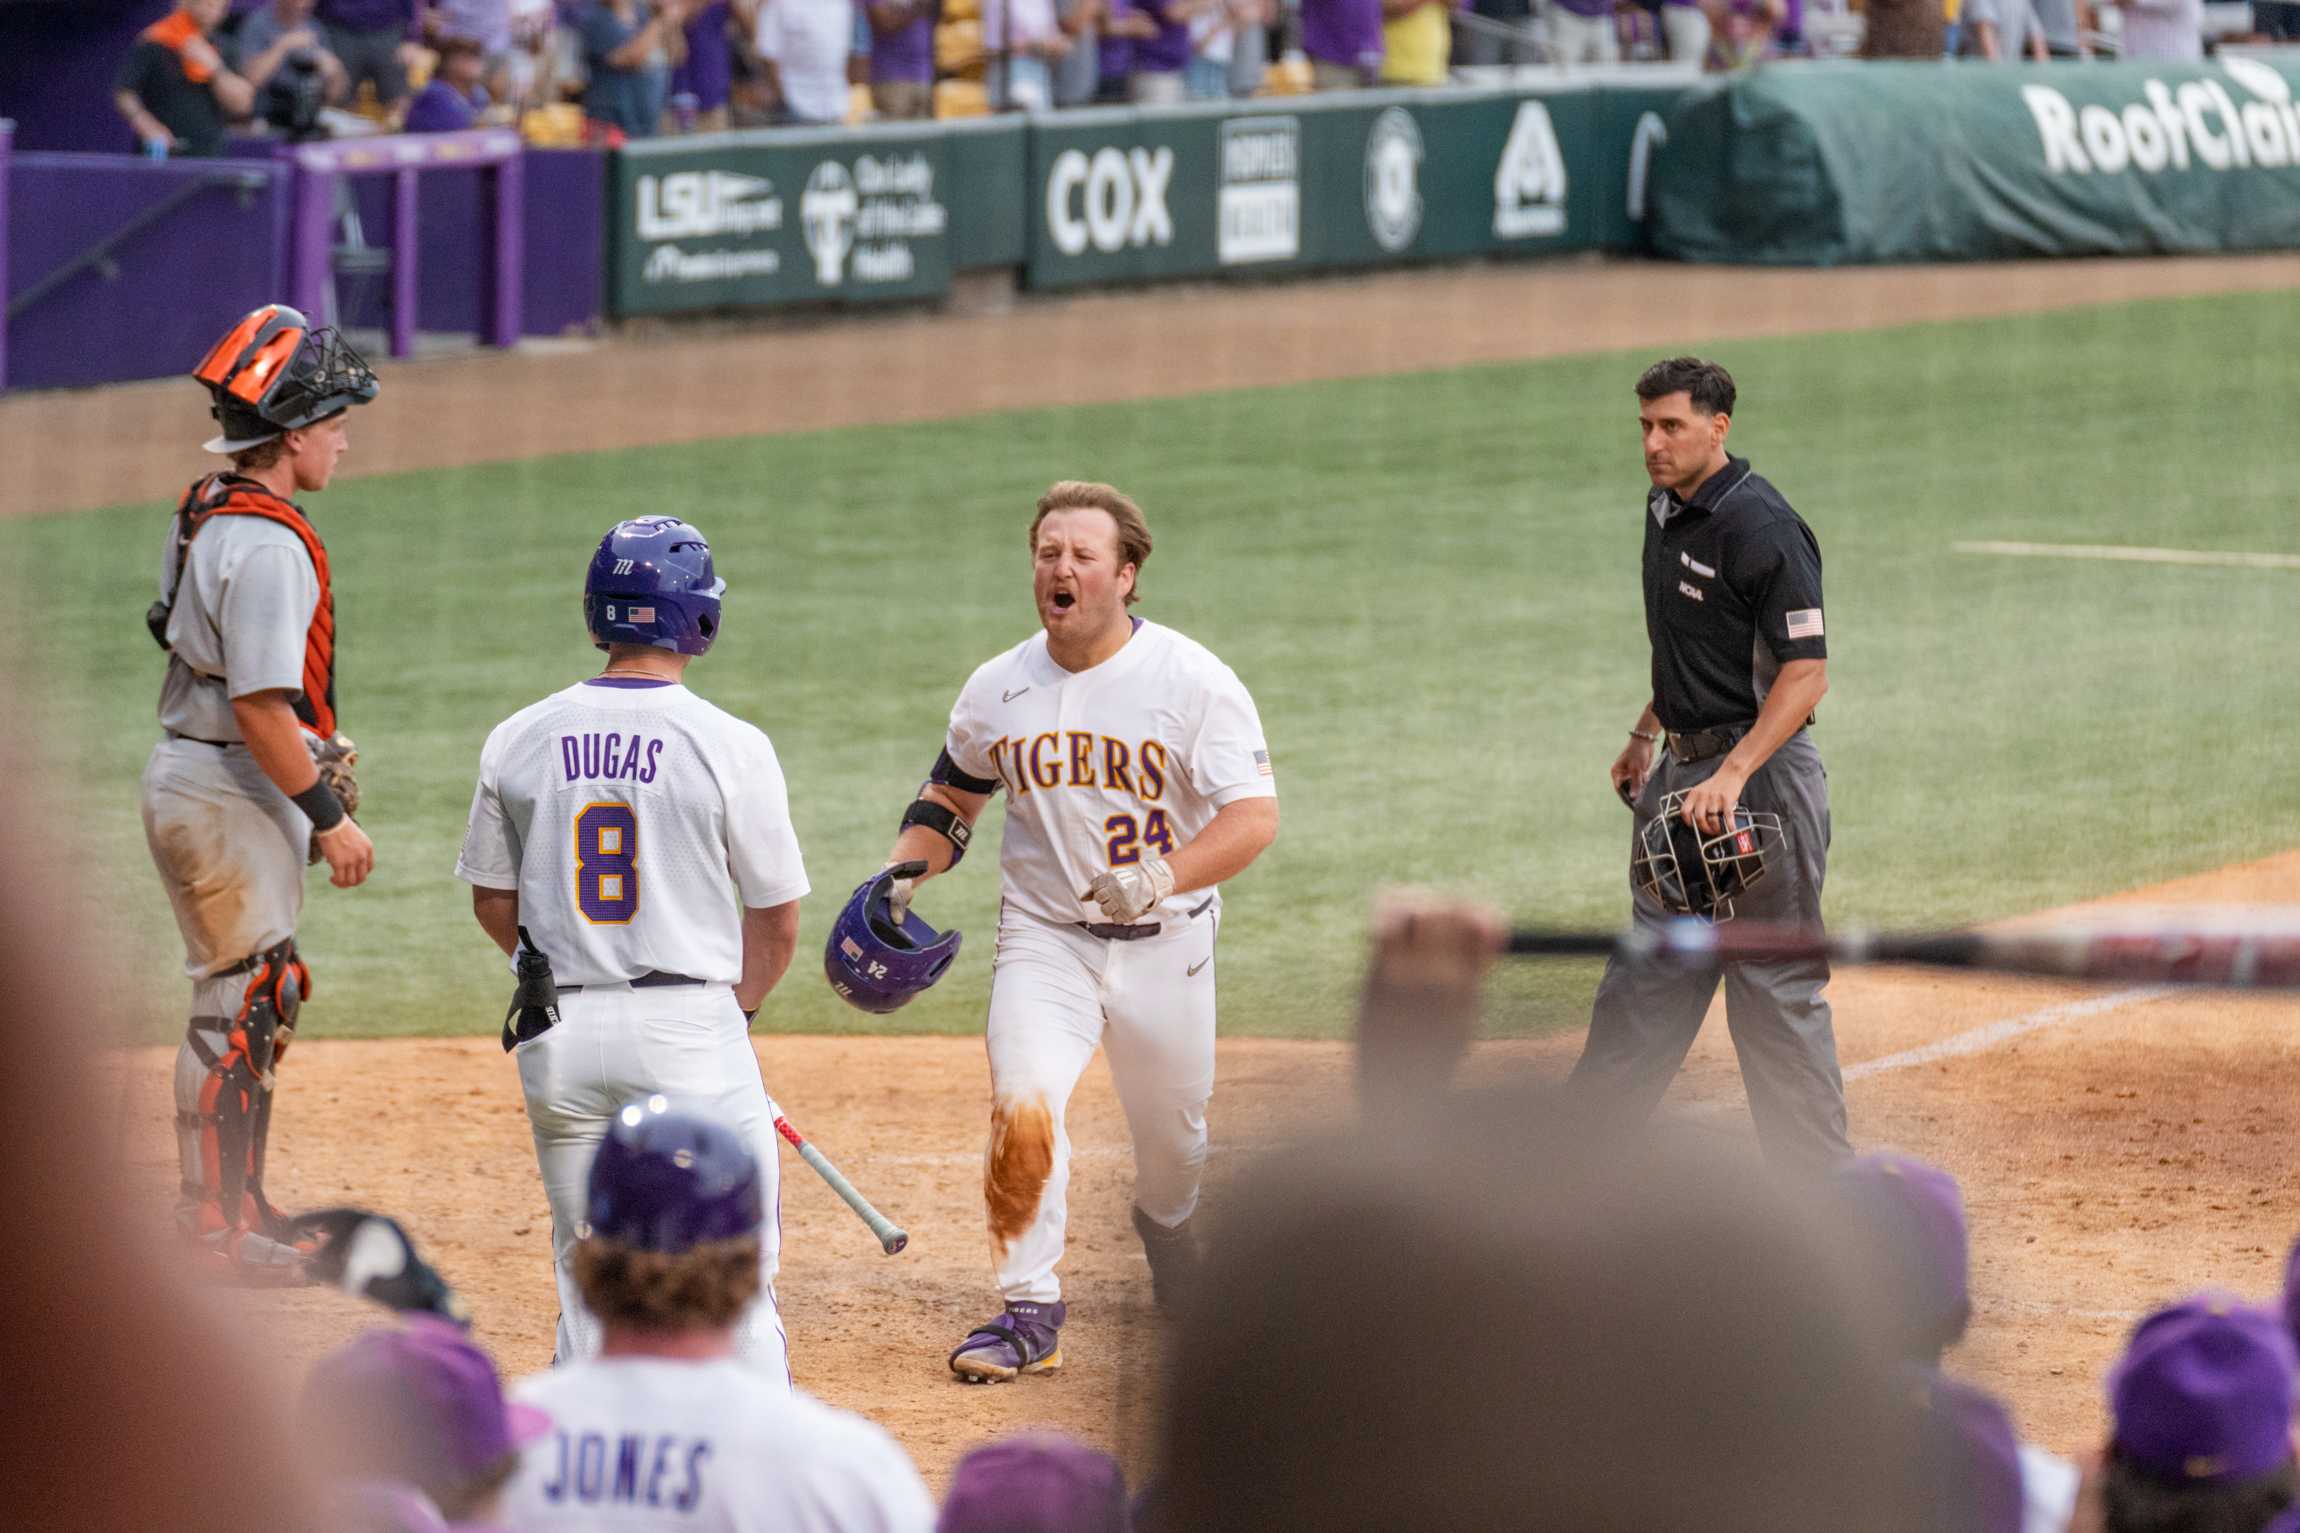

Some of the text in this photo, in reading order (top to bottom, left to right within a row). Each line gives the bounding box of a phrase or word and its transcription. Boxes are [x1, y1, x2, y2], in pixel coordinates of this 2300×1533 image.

[2020, 60, 2300, 174] RoofClai
[636, 170, 722, 240] LSU
[1047, 146, 1174, 256] COX
[606, 604, 617, 621] 8
[561, 732, 664, 785] DUGAS
[987, 730, 1168, 802] TIGERS
[574, 801, 640, 926] 8
[1104, 808, 1174, 868] 24
[866, 959, 889, 980] 24
[543, 1429, 714, 1513] JONES
